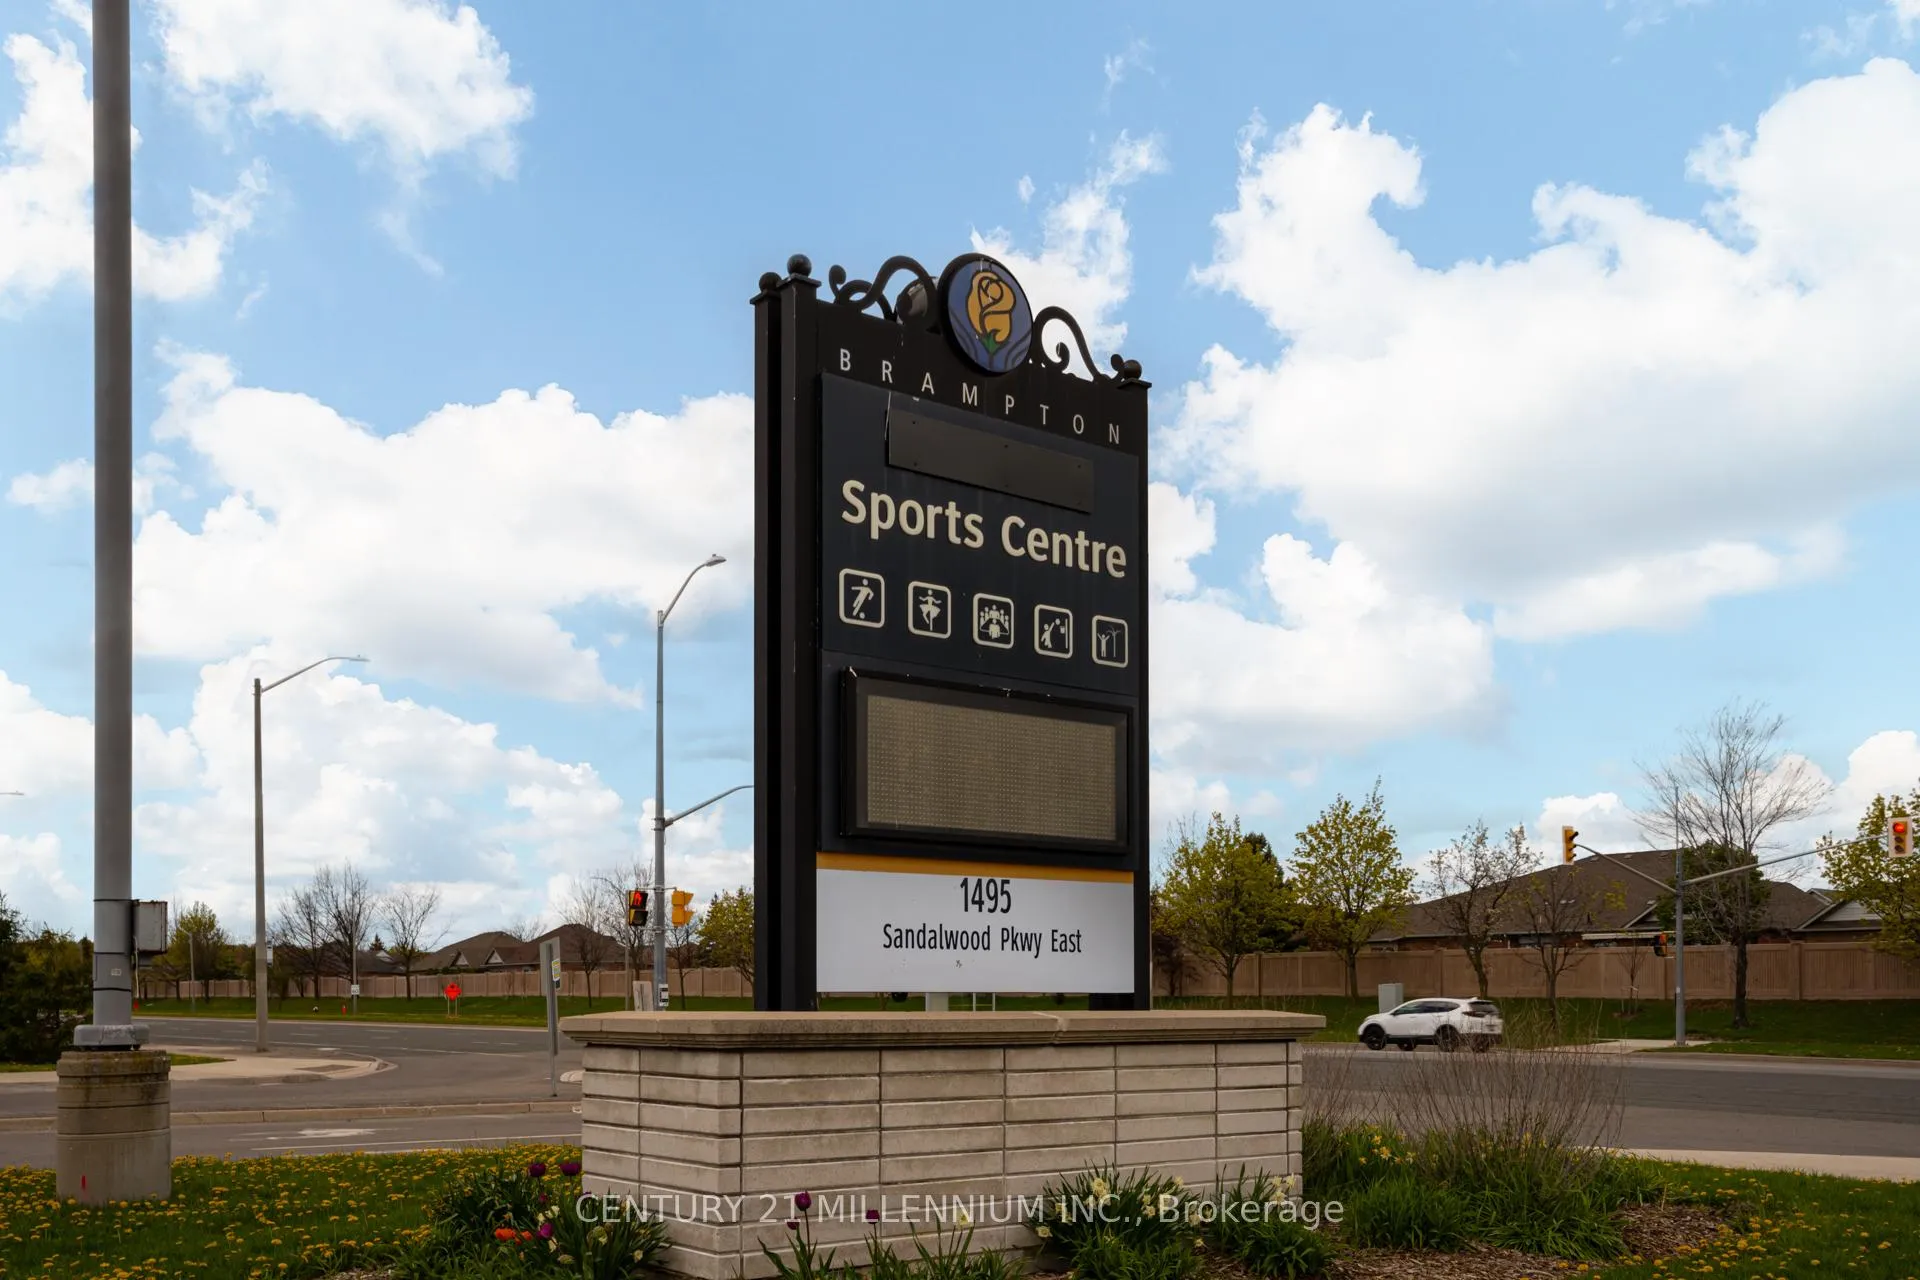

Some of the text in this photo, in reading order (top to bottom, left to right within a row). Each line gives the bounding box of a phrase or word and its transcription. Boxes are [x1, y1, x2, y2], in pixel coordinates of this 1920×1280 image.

[838, 348, 1120, 445] BRAMPTON
[841, 480, 1127, 578] Sports Centre
[960, 877, 1012, 914] 1495
[883, 923, 1082, 959] Sandalwood Pkwy East
